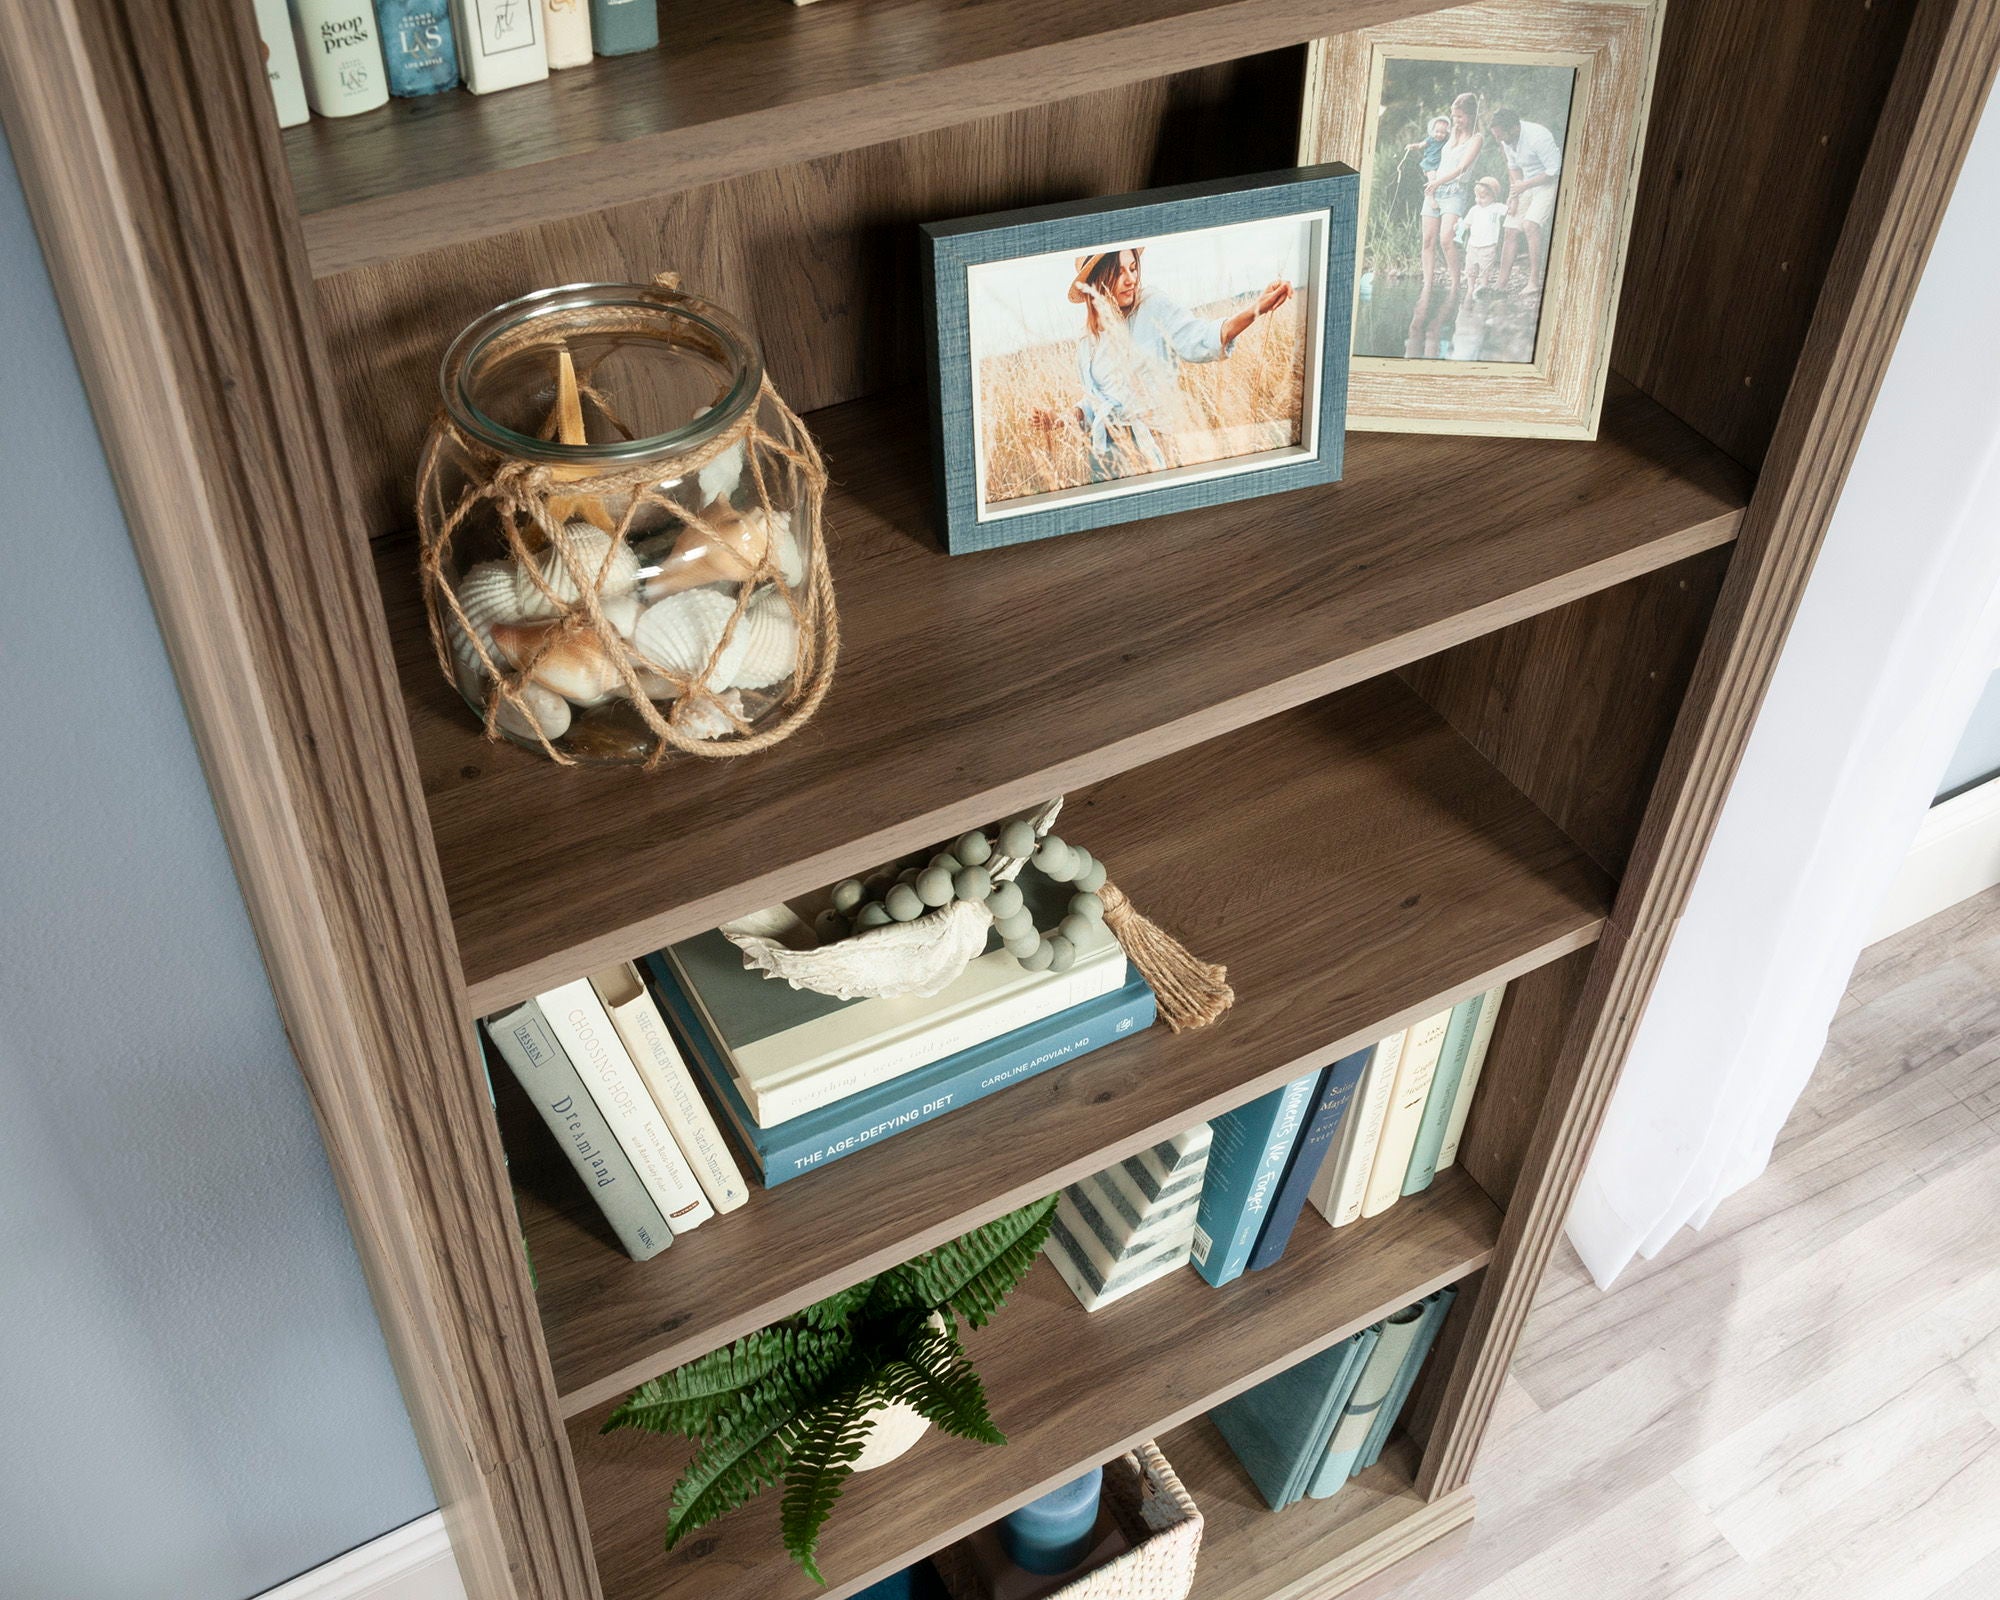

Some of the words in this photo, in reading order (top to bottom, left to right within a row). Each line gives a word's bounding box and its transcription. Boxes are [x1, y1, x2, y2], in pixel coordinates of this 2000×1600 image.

[321, 16, 362, 38] goop
[324, 30, 368, 54] press
[400, 25, 442, 58] L&S
[519, 1027, 543, 1062] DESSEN
[568, 1009, 617, 1082] CHOOSING
[608, 1081, 637, 1118] HOPE
[635, 1011, 652, 1033] SHE
[645, 1030, 666, 1060] COME
[658, 1055, 673, 1075] BY
[669, 1080, 698, 1124] NATURAL
[981, 1063, 1028, 1088] CAROLINE
[1075, 1037, 1090, 1050] MD
[794, 1150, 823, 1169] THE
[827, 1109, 919, 1157] AGE-DEFYING
[923, 1093, 954, 1115] DIET
[1277, 1079, 1311, 1138] Moments
[693, 1127, 714, 1157] Sarah
[705, 1152, 729, 1188] Smarsh
[1266, 1141, 1289, 1168] We
[1247, 1171, 1276, 1215] Forget
